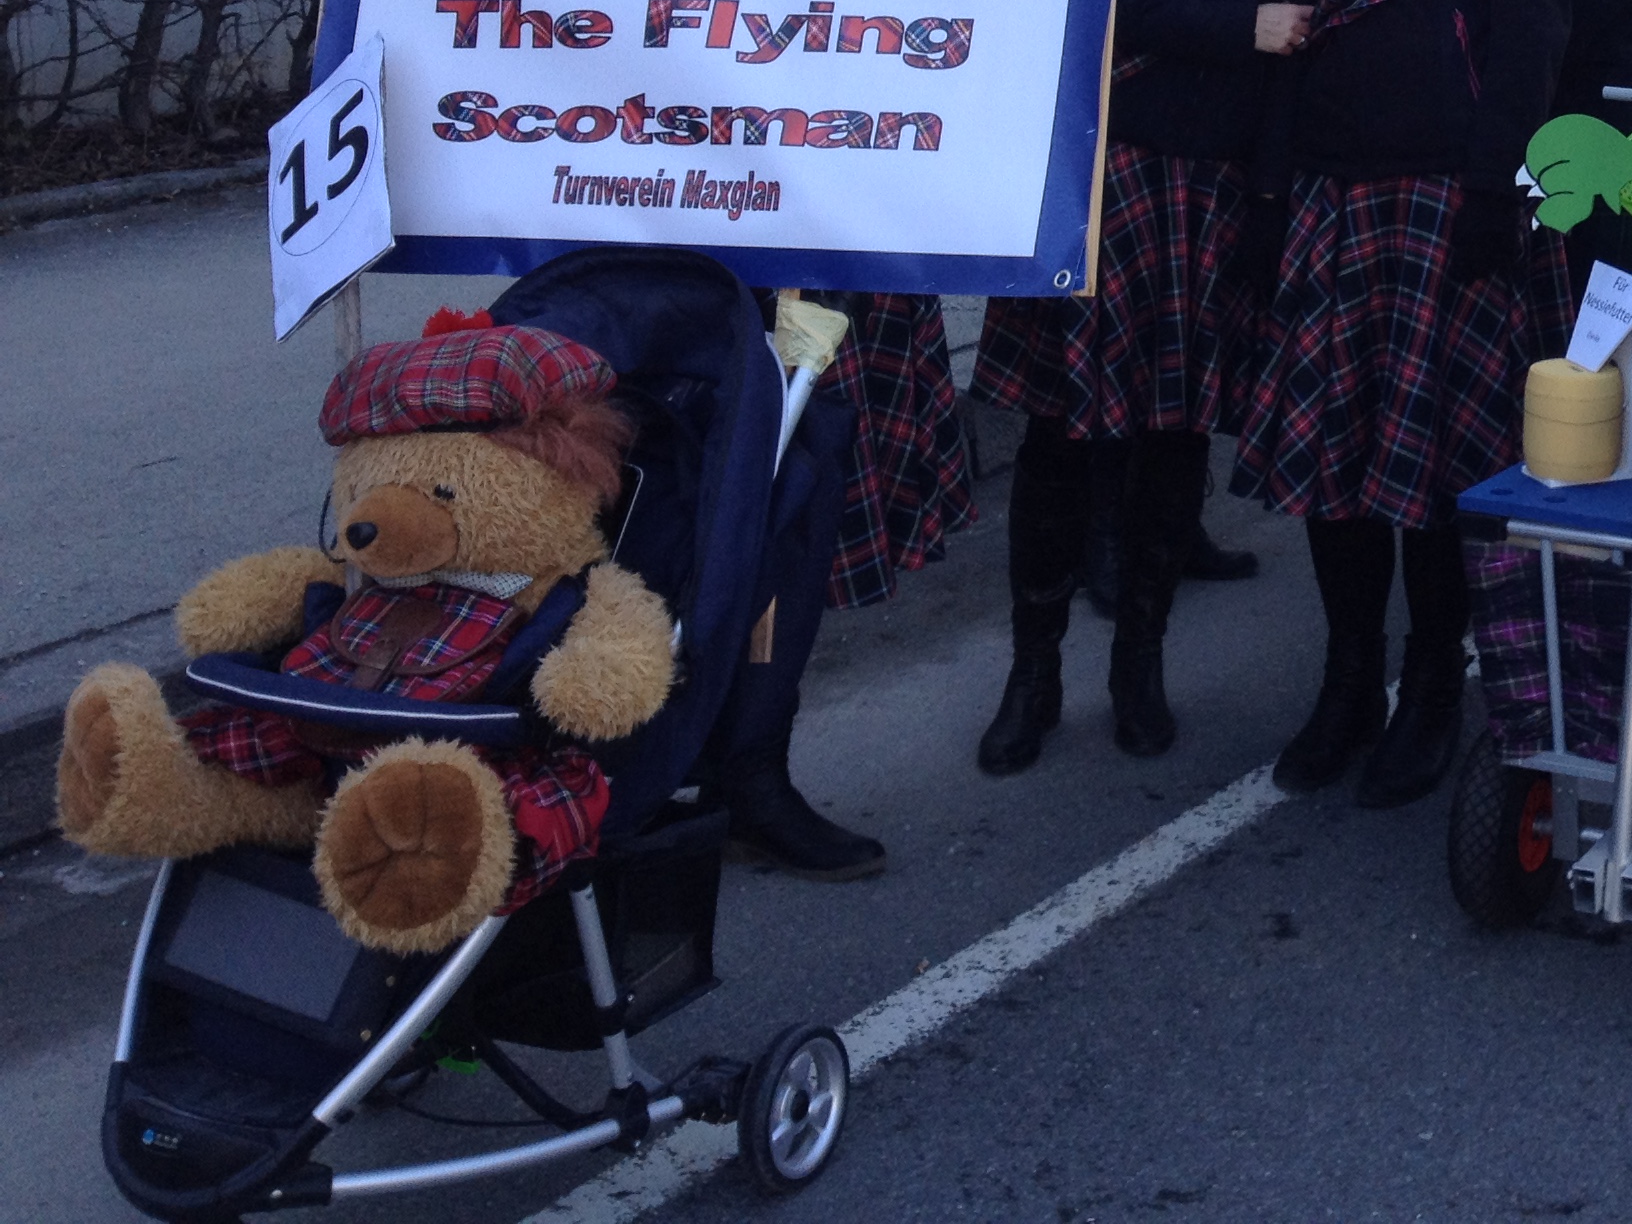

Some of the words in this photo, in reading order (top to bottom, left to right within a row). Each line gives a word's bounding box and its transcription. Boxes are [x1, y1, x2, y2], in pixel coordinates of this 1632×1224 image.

[432, 90, 944, 151] Scotsman
[279, 88, 369, 245] 15
[552, 165, 677, 208] Turnverein
[679, 169, 781, 222] Maxglan
[1613, 276, 1630, 292] Für
